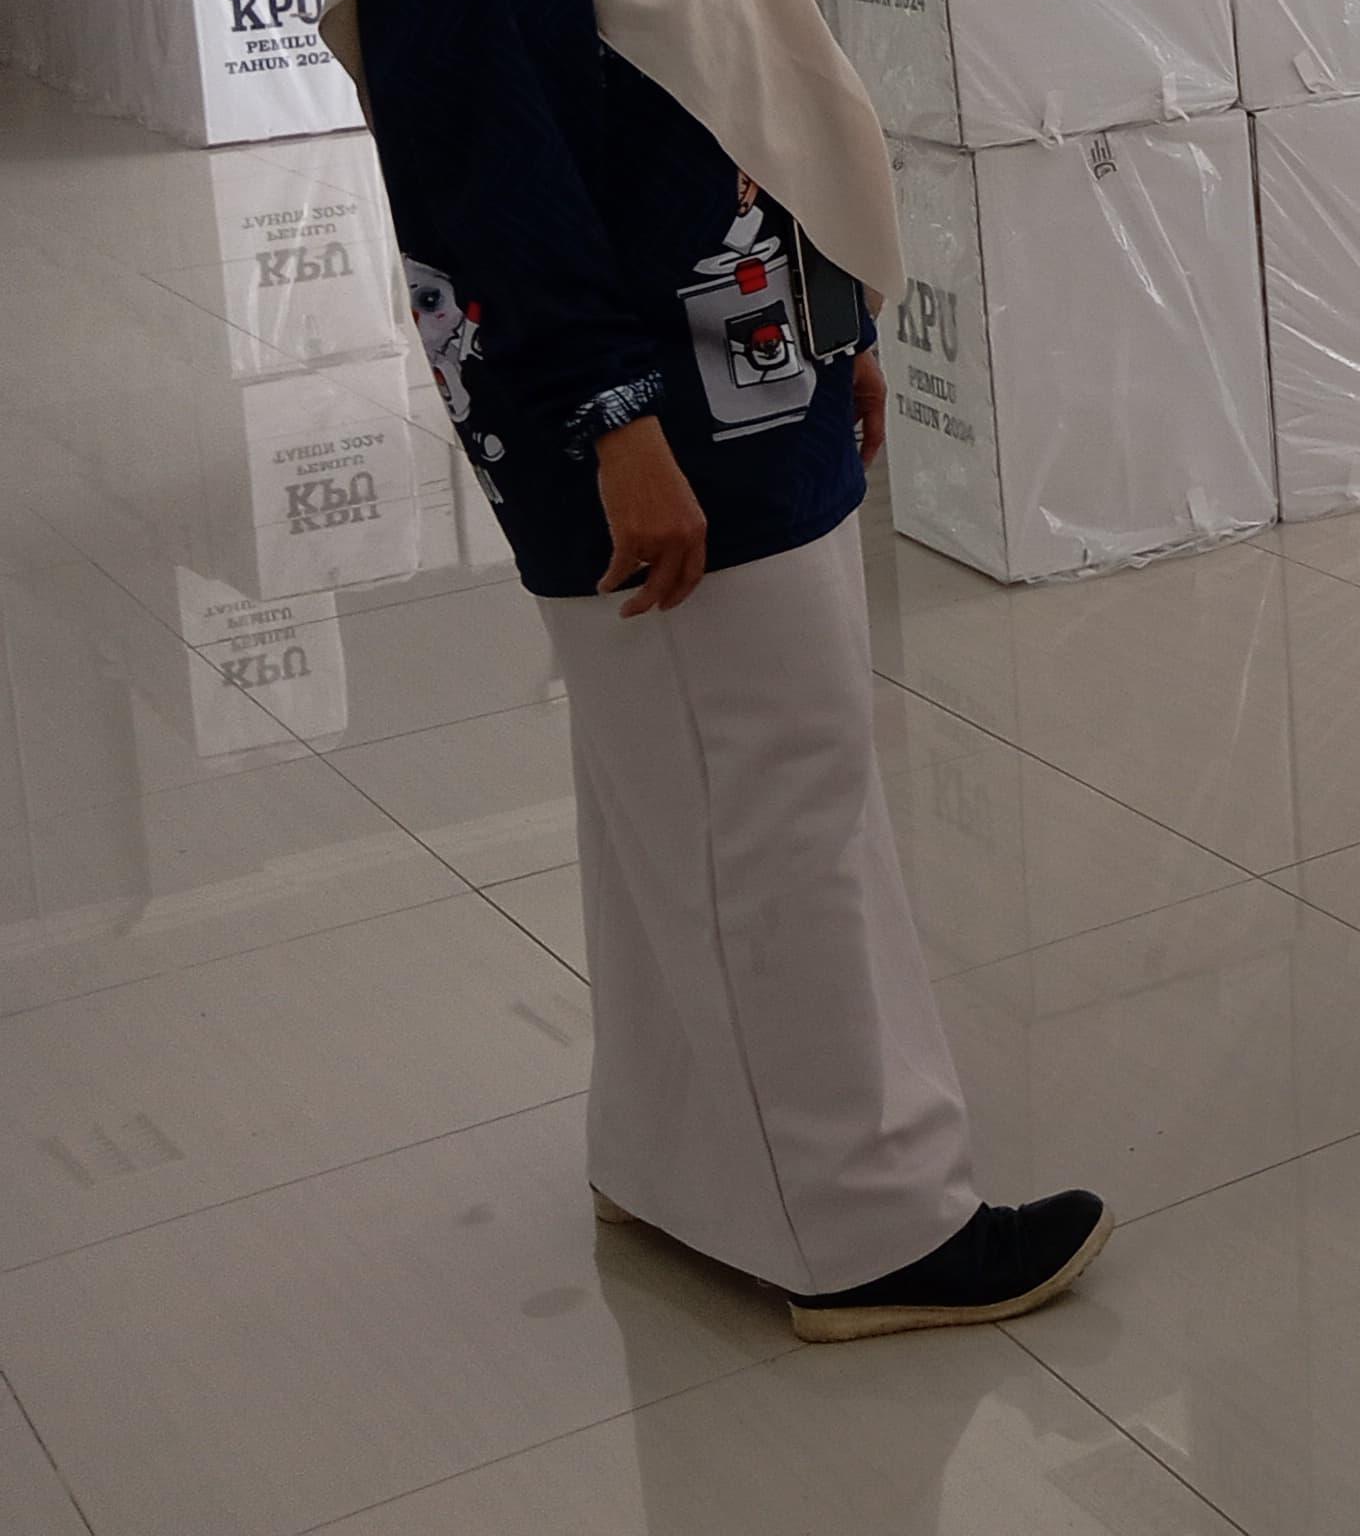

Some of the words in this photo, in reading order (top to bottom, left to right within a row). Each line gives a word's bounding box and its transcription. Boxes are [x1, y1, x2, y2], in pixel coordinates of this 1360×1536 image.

[246, 34, 317, 53] PEMILU
[225, 56, 289, 74] TAHUN
[296, 52, 335, 66] 202
[897, 278, 958, 362] KPU
[908, 365, 956, 404] PEMILU
[896, 393, 940, 430] TAHUN
